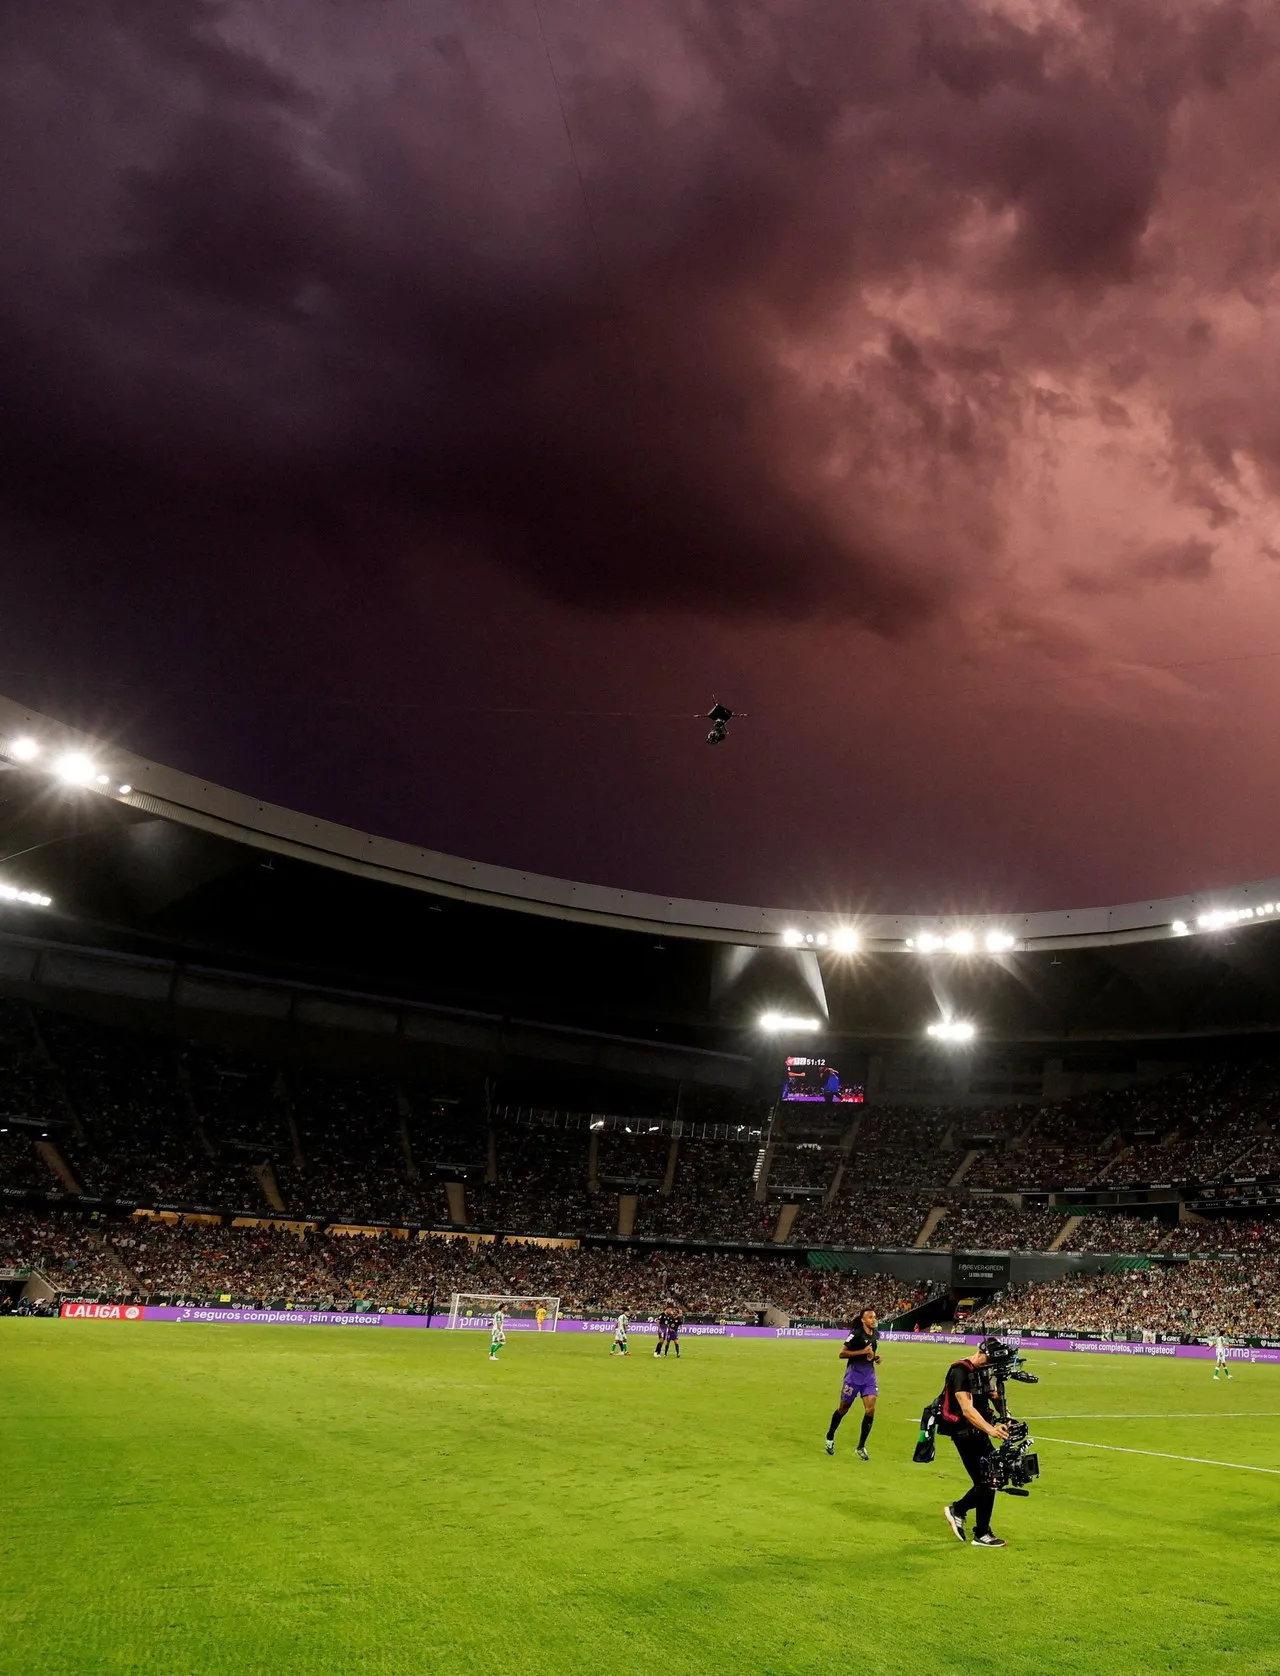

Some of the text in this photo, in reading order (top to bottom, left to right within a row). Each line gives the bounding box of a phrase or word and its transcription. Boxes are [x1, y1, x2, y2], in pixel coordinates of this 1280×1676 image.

[65, 1306, 121, 1318] LALIGA
[183, 1309, 380, 1325] 3 seguros completos, ¡sin regateos!
[689, 1326, 725, 1335] regateos!
[776, 1328, 803, 1338] prima
[911, 1334, 935, 1342] completos,
[945, 1336, 966, 1344] regateos!
[1075, 1343, 1098, 1351] seguros
[1099, 1343, 1132, 1353] completos,
[1133, 1344, 1144, 1354] ¡sin
[1145, 1346, 1176, 1356] regateos!
[1223, 1347, 1250, 1358] prima
